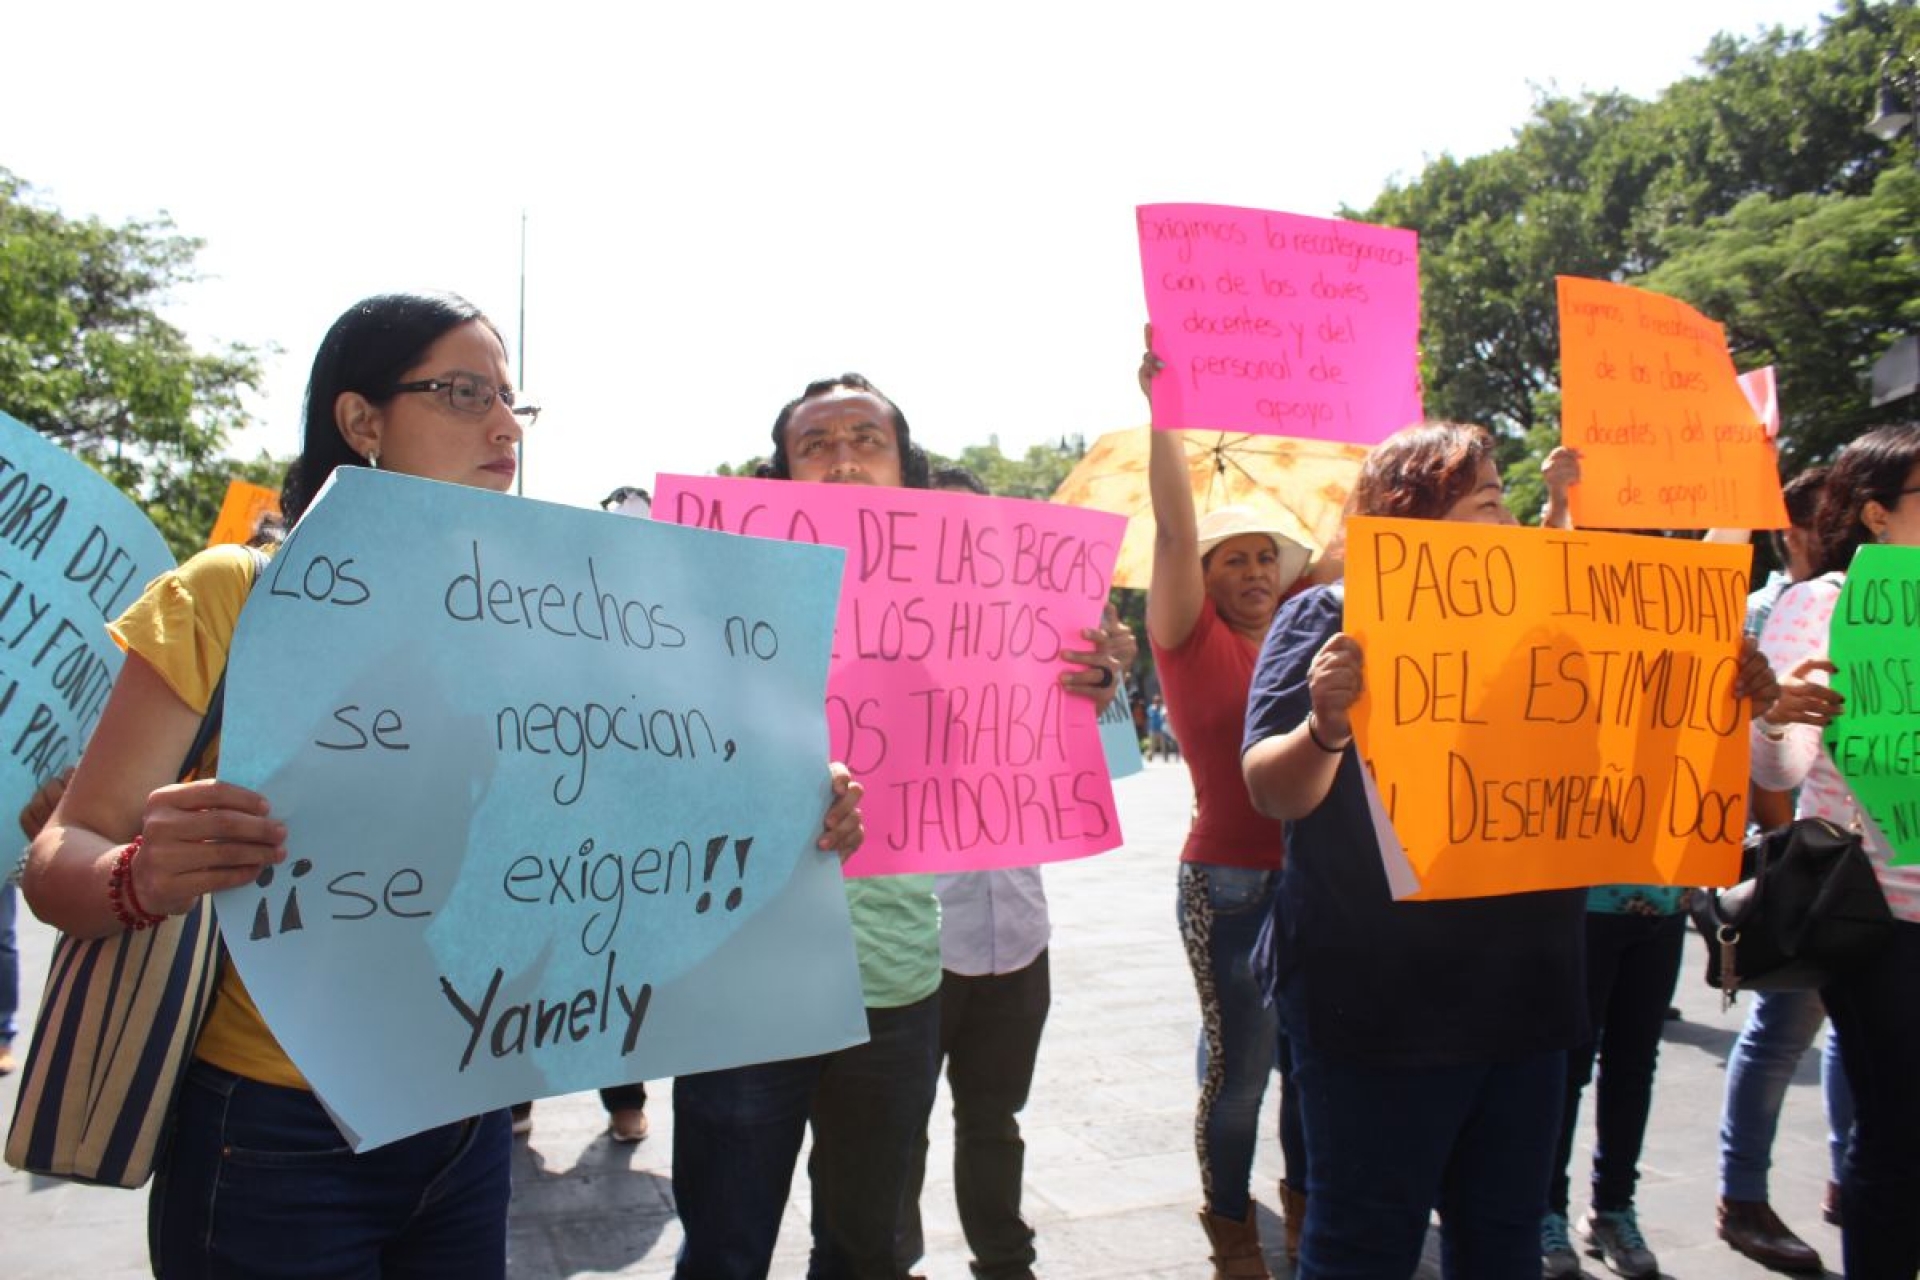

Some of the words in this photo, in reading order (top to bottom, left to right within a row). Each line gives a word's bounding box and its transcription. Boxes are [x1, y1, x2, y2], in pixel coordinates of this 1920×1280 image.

[1264, 215, 1286, 251] la
[1216, 270, 1250, 296] de
[1261, 269, 1297, 298] las
[1182, 308, 1282, 338] docentes
[1289, 320, 1304, 359] y
[1317, 312, 1356, 345] del
[1191, 349, 1292, 391] personal
[1309, 355, 1349, 385] de
[1594, 349, 1617, 382] de
[1617, 473, 1644, 506] de
[64, 524, 138, 622] DEL
[857, 507, 919, 583] DE
[935, 516, 1004, 589] LAS
[1010, 521, 1114, 601] BECAS
[1373, 532, 1517, 622] PAGO
[444, 540, 687, 651] derechos
[724, 613, 779, 661] no
[853, 597, 935, 662] LOS
[946, 600, 1061, 664] HIJOS
[1846, 578, 1894, 626] LOS
[1394, 650, 1488, 726] DEL
[1523, 646, 1742, 737] ESTIMULO
[1849, 660, 1882, 720] NO
[1884, 656, 1920, 717] SE
[315, 704, 411, 751] se
[496, 695, 739, 806] negocian,
[886, 770, 1110, 854] JADORES
[1448, 750, 1647, 844] DESEMPEÑO
[439, 951, 653, 1072] Yanely
